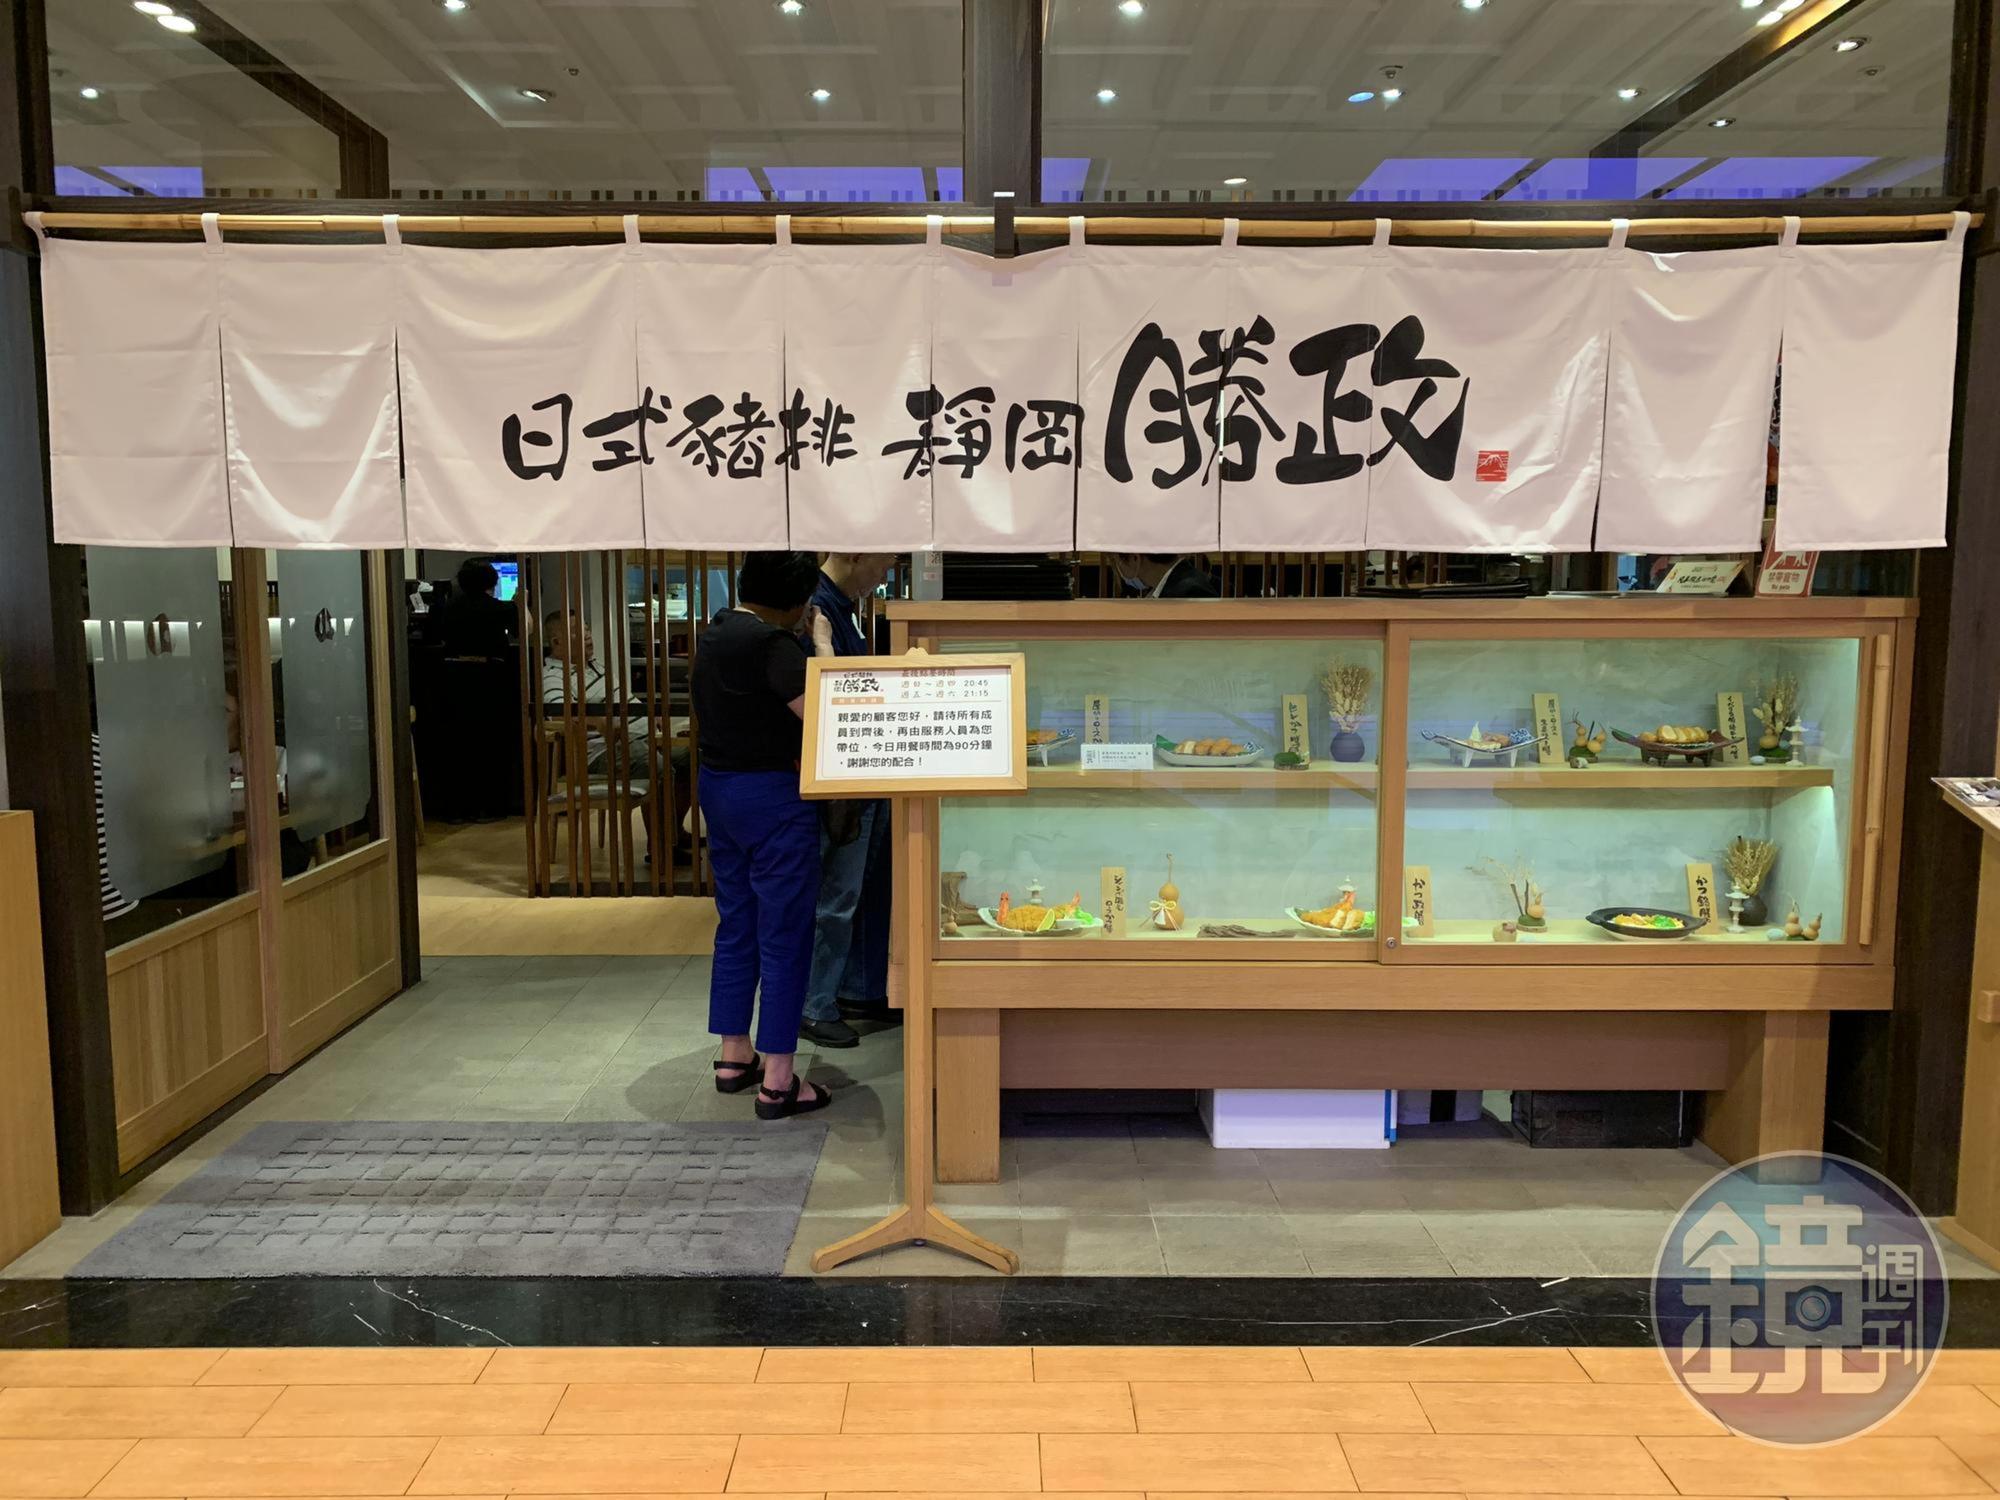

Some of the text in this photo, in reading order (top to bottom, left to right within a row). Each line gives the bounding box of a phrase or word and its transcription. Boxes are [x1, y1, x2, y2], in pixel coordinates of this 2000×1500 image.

[502, 314, 1470, 490] 日式豬排 靜岡 勝政
[963, 679, 989, 687] 20:45
[963, 690, 989, 698] 21:15
